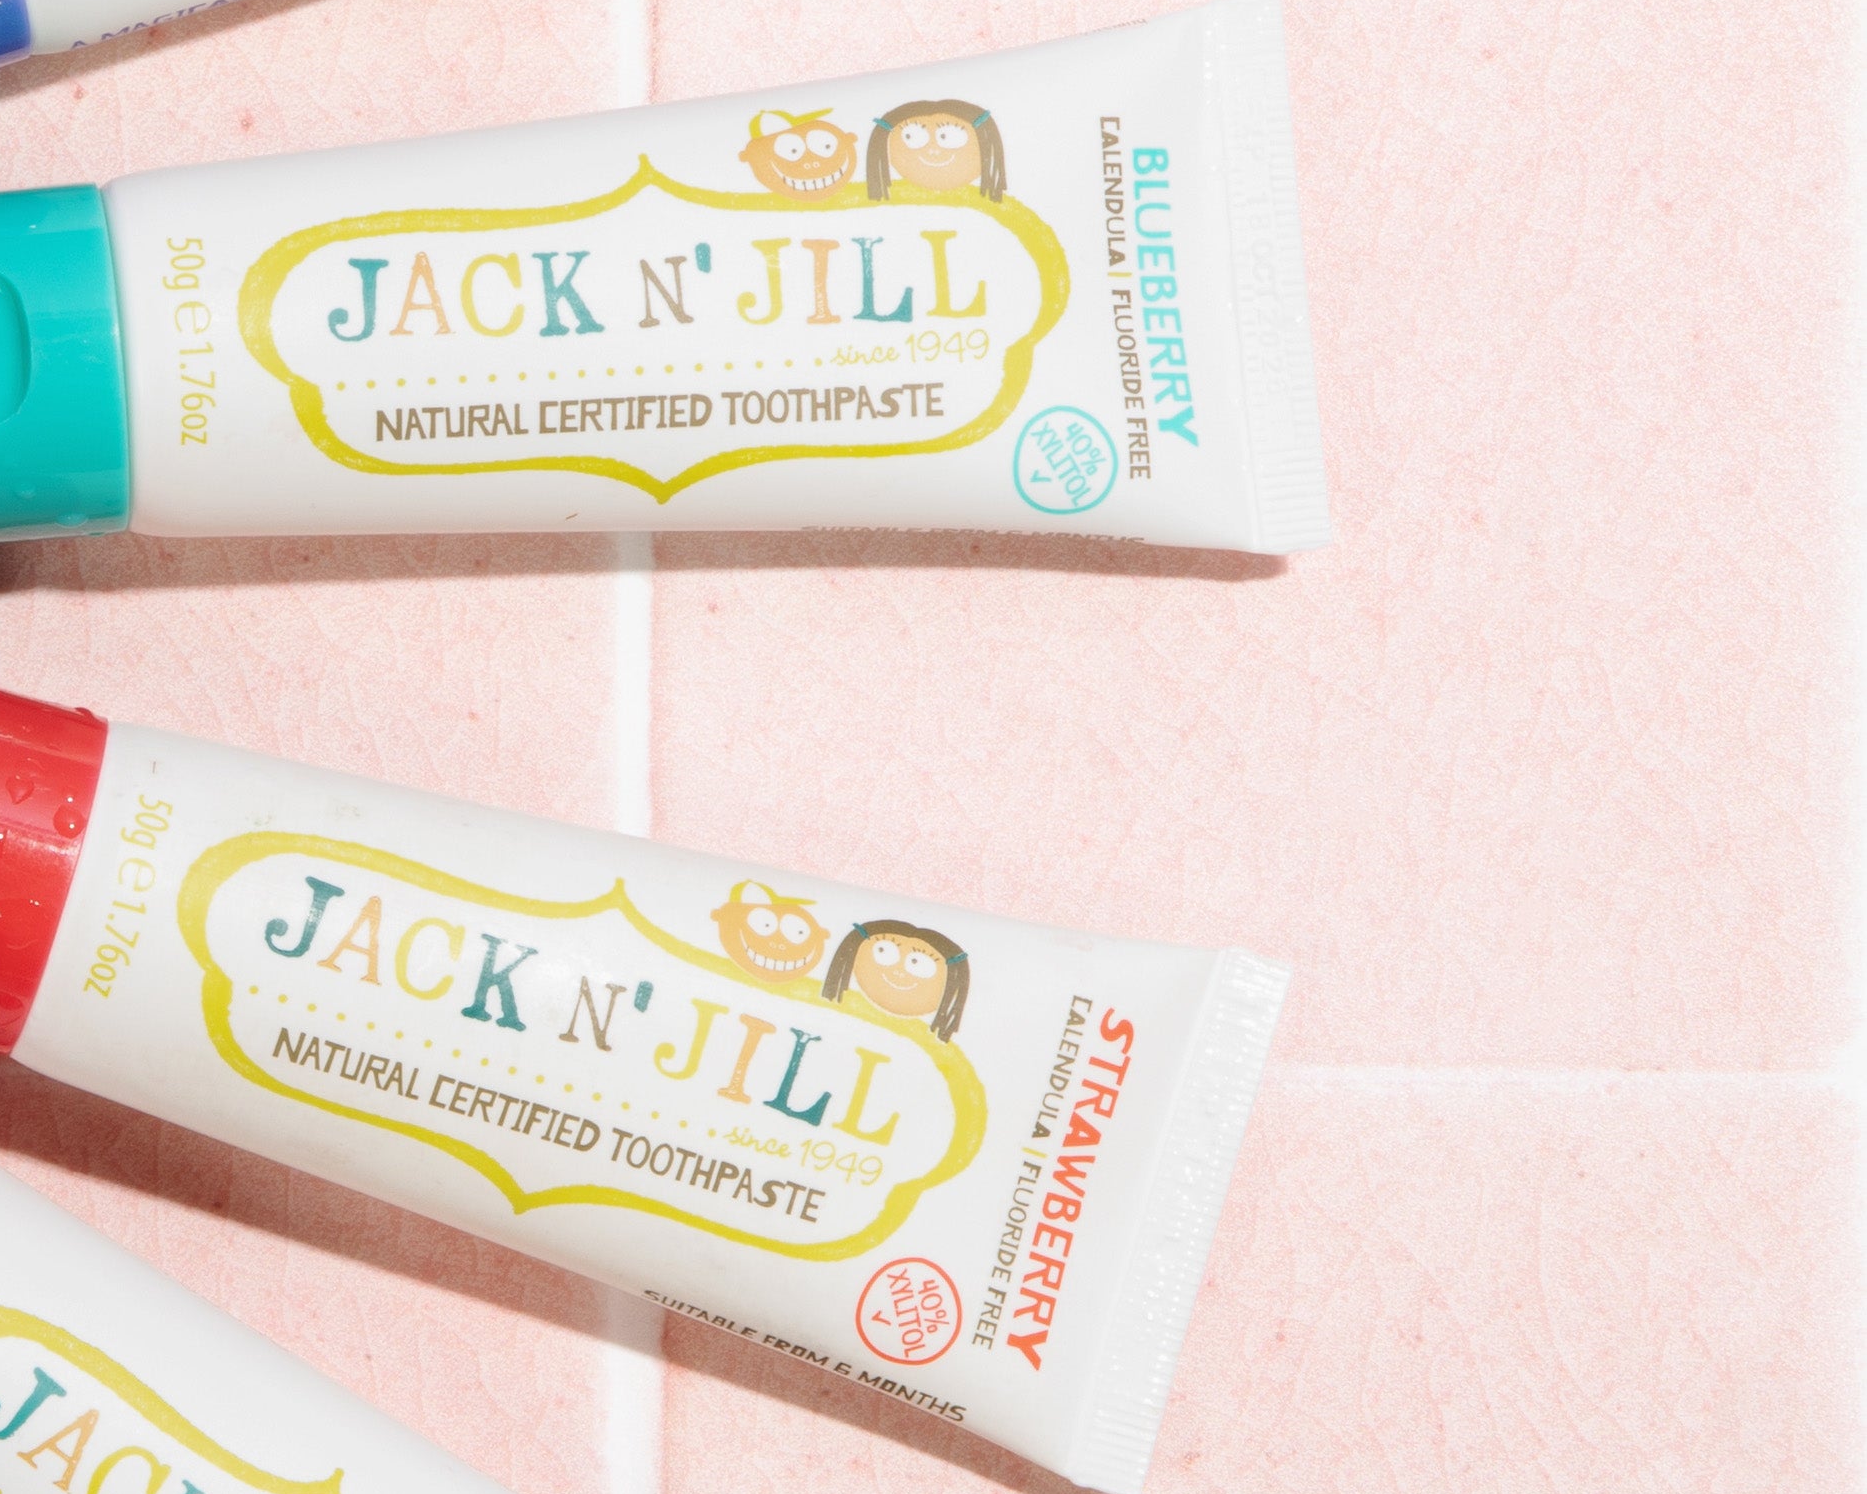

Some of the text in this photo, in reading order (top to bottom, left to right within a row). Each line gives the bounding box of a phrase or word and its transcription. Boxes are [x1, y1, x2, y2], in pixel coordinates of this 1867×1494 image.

[162, 238, 206, 291] 50g
[327, 230, 987, 342] JACK N' JILL
[1100, 117, 1151, 479] CALENDULA FLUORIDE FREE
[1132, 147, 1199, 447] BLUEBERRY
[830, 328, 990, 367] since 1949
[179, 342, 216, 446] 1.76oz
[376, 382, 944, 442] NATURAL CERTIFIED TOOTHPASTE
[1031, 423, 1091, 510] XYLITOL
[1066, 422, 1106, 476] 40%
[119, 794, 173, 850] 50g
[82, 901, 146, 999] 1.76oz
[264, 876, 901, 1140] JACK N' JILL
[272, 1027, 826, 1223] NATURAL CERTIFIED TOOTHPASTE
[723, 1127, 884, 1187] since 1949
[972, 995, 1093, 1350] CALENDULA FLUORIDE FREE
[1006, 1008, 1134, 1371] STRAWBERRY
[887, 1269, 926, 1361] XYLITOL
[919, 1279, 949, 1334] 40%
[761, 1332, 830, 1367] FROM
[832, 1358, 854, 1377] 6
[856, 1368, 968, 1422] MONTHS
